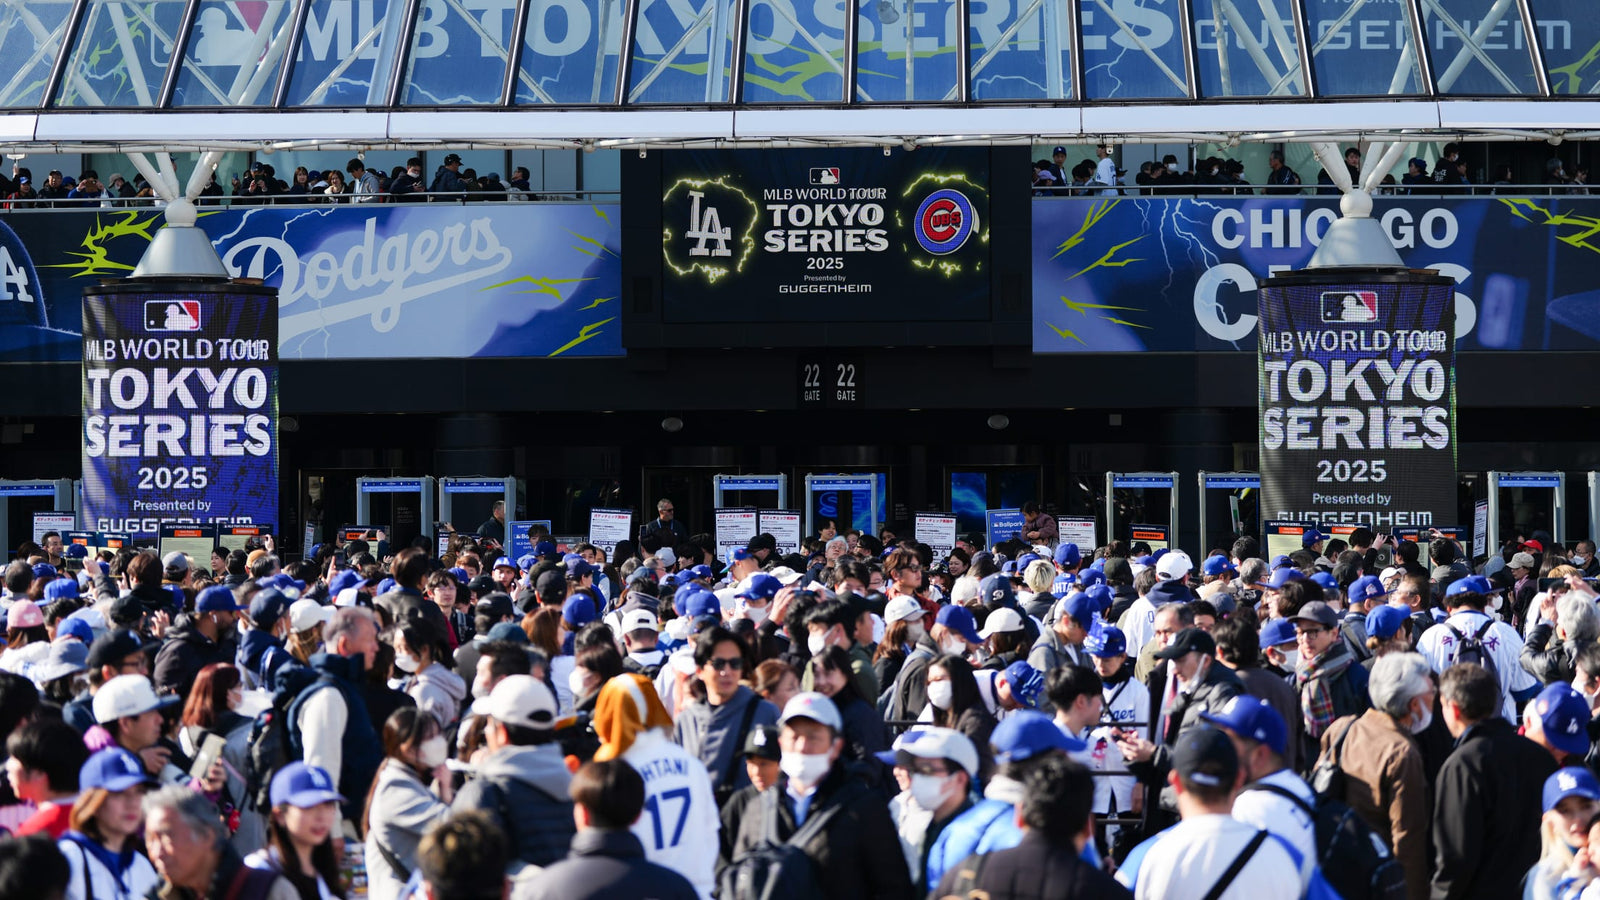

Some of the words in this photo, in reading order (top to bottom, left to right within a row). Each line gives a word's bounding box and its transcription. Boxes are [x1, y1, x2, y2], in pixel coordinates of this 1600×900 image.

[763, 188, 793, 200] MLB
[795, 188, 847, 200] WORLD
[848, 187, 887, 200] TOUR
[685, 190, 732, 257] LA
[766, 203, 885, 227] TOKYO
[1211, 208, 1459, 249] CHICGO
[763, 229, 889, 253] SERIES
[806, 257, 845, 270] 2025
[779, 284, 872, 294] GUGGENHEIM
[803, 274, 837, 282] Presented
[837, 274, 846, 283] by
[86, 339, 116, 361] MLB
[120, 338, 214, 361] WORLD
[216, 338, 269, 361] TOUR
[1262, 331, 1293, 353] MLB
[1296, 330, 1391, 352] WORLD
[1393, 329, 1446, 352] TOUR
[804, 364, 820, 388] 22
[837, 363, 856, 388] 22
[1264, 359, 1445, 401] TOKYO
[87, 367, 267, 409] TOKYO
[804, 391, 820, 401] GATE
[837, 391, 856, 401] GATE
[86, 413, 271, 458] SERIES
[1263, 405, 1449, 450] SERIES
[137, 466, 208, 490] 2025
[1316, 460, 1387, 483] 2025
[133, 499, 195, 511] Presented
[196, 499, 212, 513] by
[1312, 493, 1375, 505] Presented
[1376, 493, 1392, 506] by
[640, 758, 689, 782] HTANI
[643, 786, 692, 850] 17
